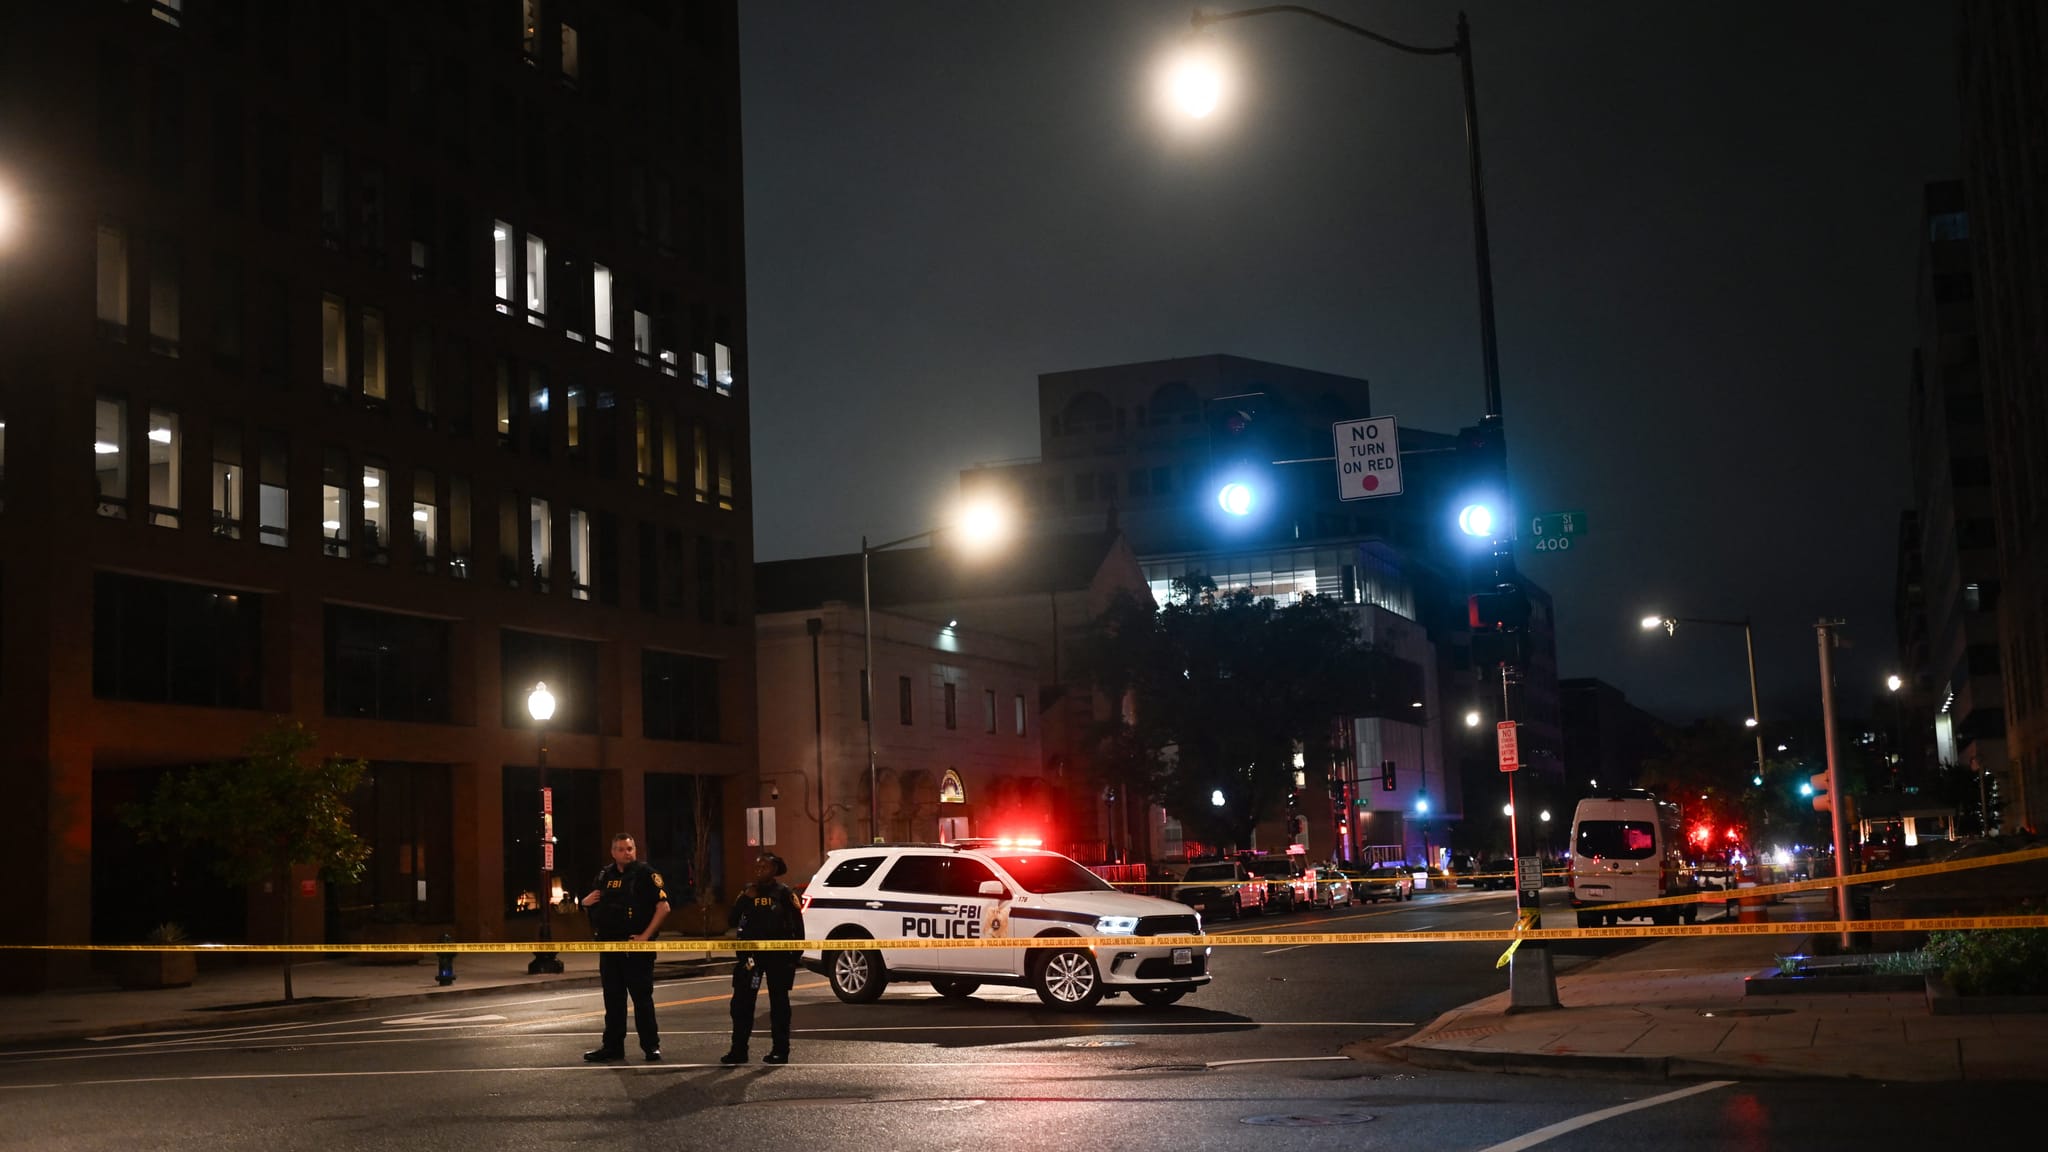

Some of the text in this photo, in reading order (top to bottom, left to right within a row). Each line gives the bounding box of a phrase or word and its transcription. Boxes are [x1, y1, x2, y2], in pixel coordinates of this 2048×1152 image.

[1352, 425, 1378, 441] NO
[1349, 442, 1385, 457] TURN
[1343, 457, 1394, 474] ON RED
[1532, 517, 1542, 536] G
[1535, 537, 1569, 551] 400
[606, 880, 622, 889] FBI
[754, 897, 772, 907] FBI
[959, 905, 981, 919] FBI
[902, 917, 980, 939] POLICE
